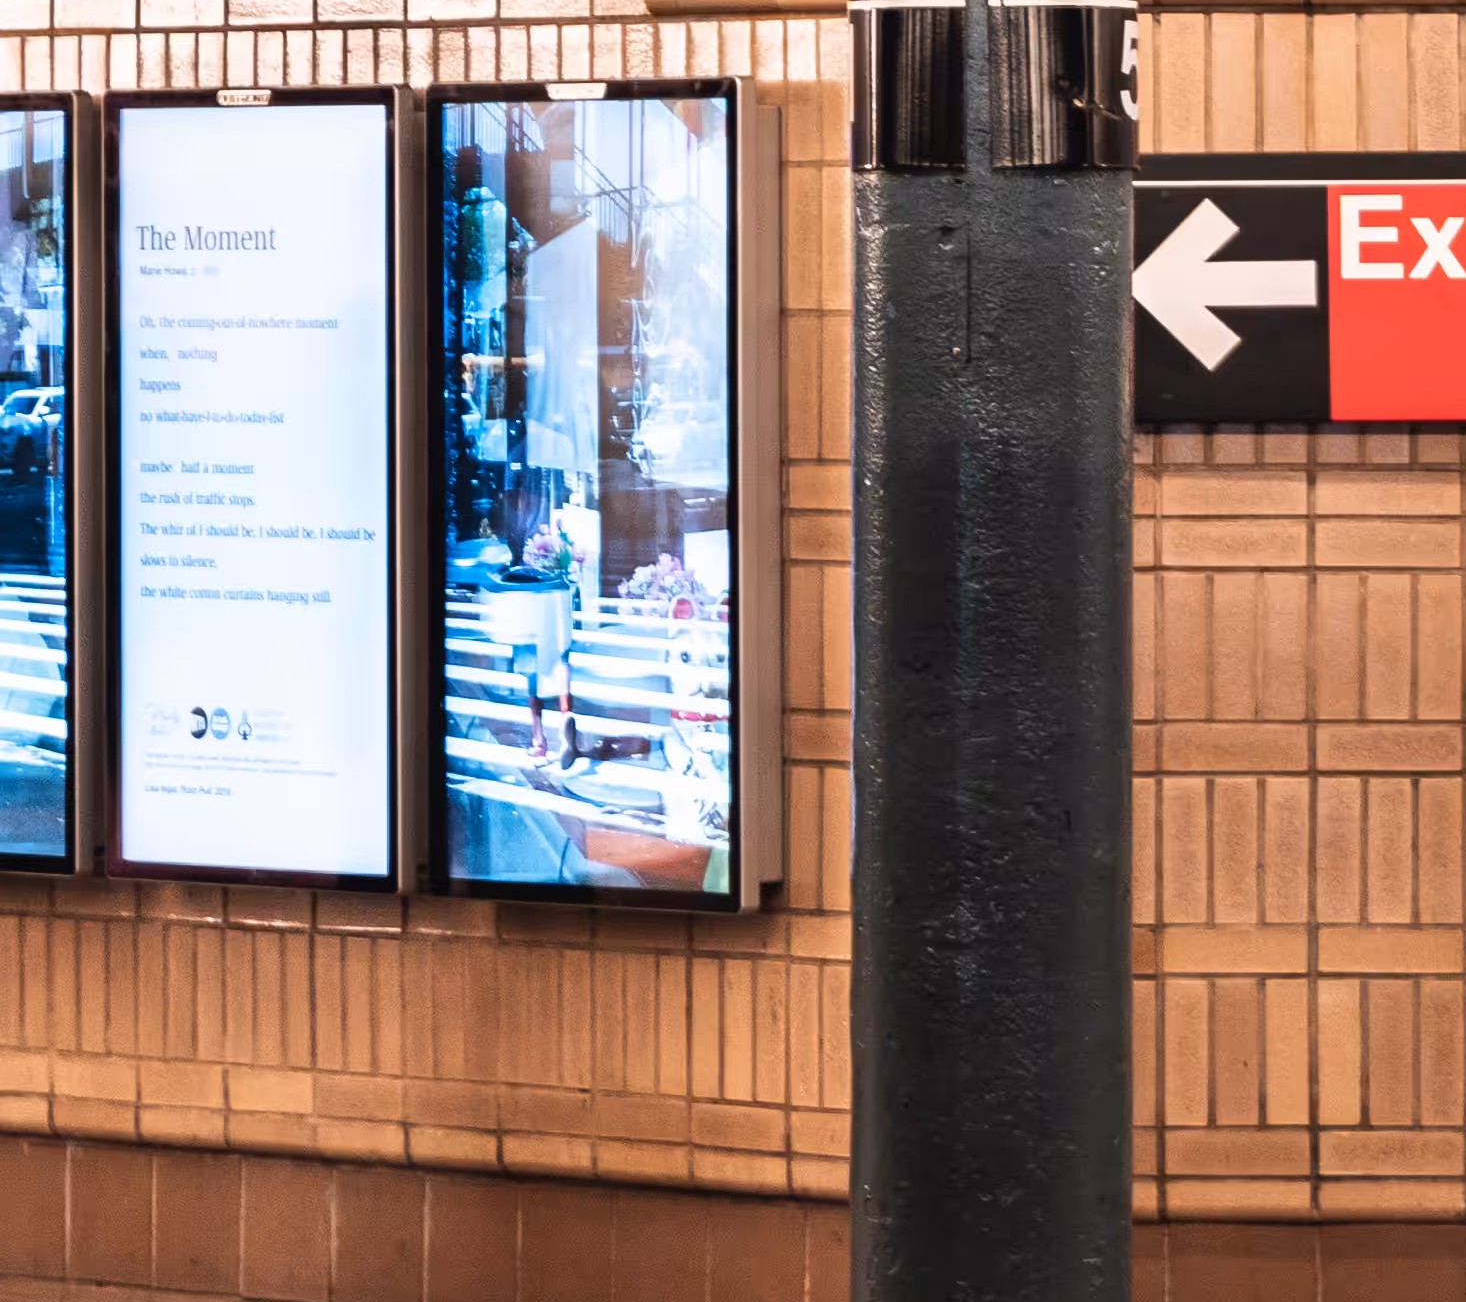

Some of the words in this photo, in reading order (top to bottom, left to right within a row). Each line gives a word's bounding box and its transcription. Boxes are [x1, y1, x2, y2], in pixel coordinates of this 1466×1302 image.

[136, 225, 176, 250] The
[184, 226, 277, 250] Moment
[139, 378, 181, 394] happens
[212, 463, 254, 475] moment
[140, 492, 157, 504] the
[159, 492, 180, 504] rush
[140, 523, 159, 535] The
[206, 525, 239, 538] should
[267, 526, 299, 539] should
[327, 528, 361, 541] should
[141, 585, 157, 597] the
[223, 589, 264, 601] curtains
[267, 590, 309, 605] hanging
